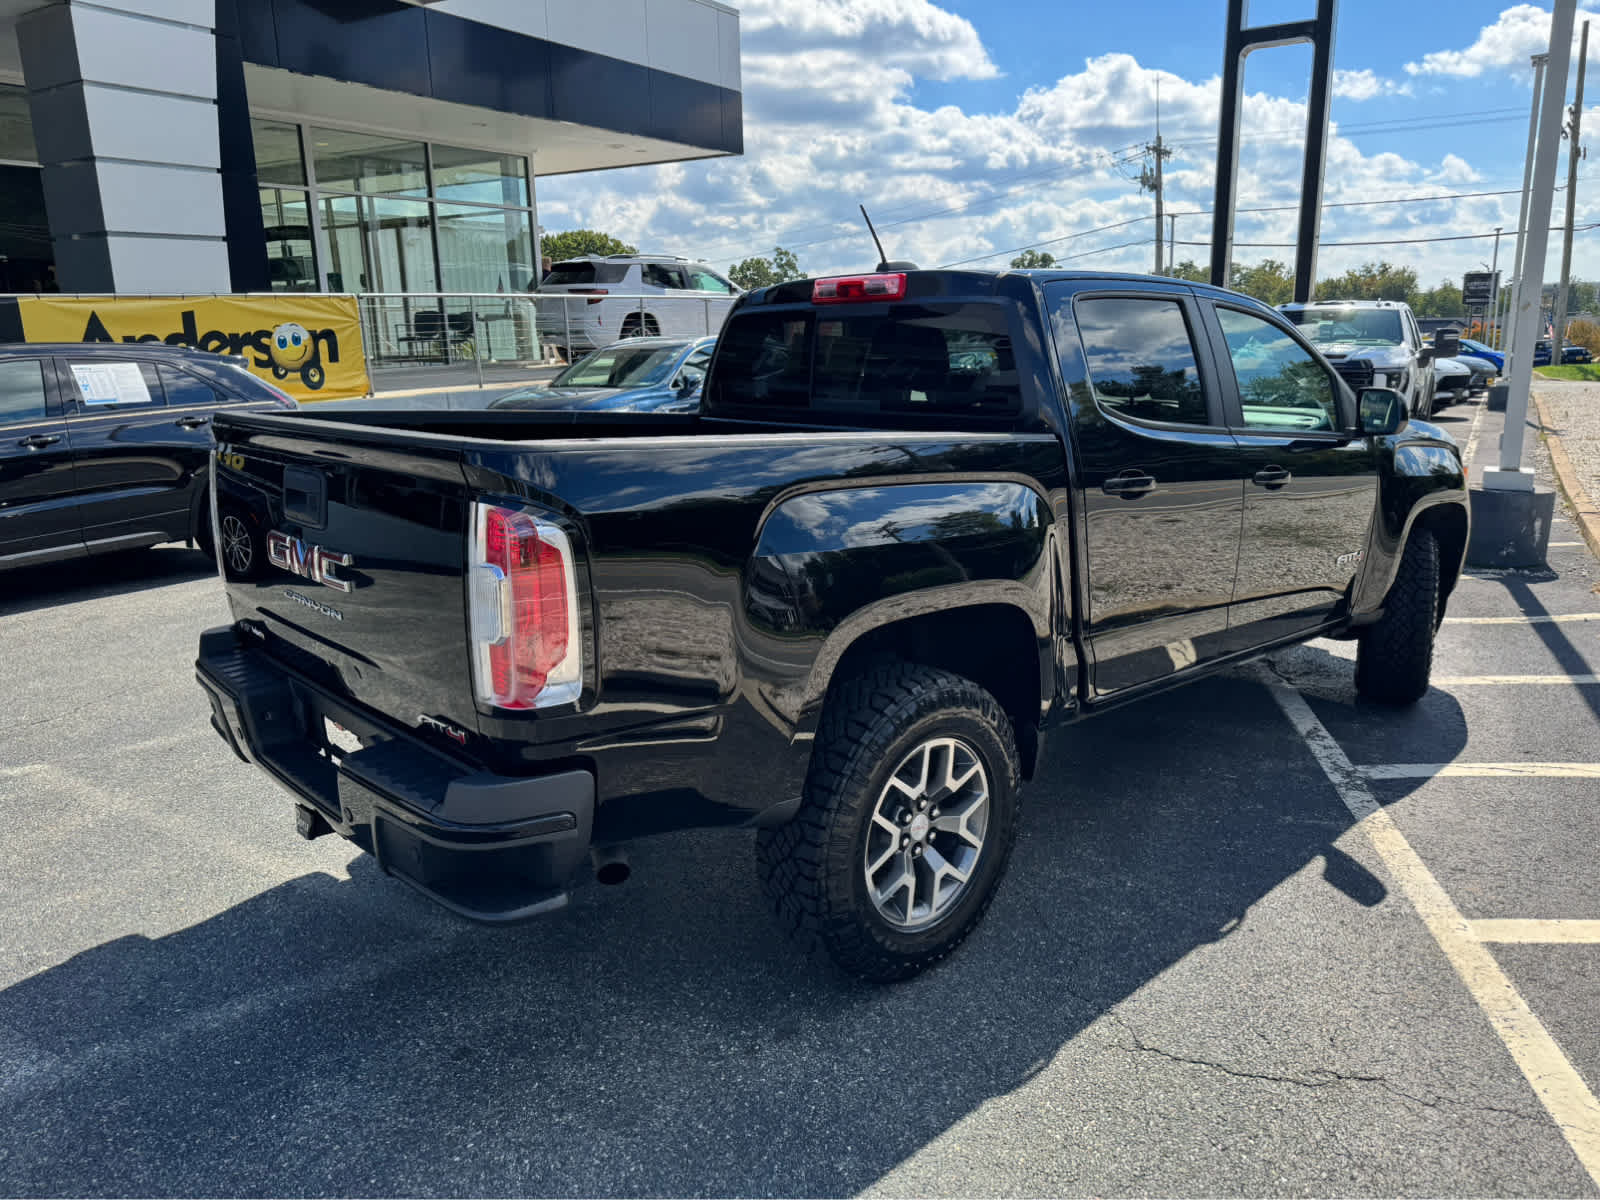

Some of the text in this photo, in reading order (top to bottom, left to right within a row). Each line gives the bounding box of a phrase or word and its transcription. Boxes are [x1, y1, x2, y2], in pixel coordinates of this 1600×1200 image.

[83, 310, 339, 369] Aderson
[267, 529, 351, 592] GMC
[284, 588, 343, 620] CANYON
[417, 714, 465, 745] AT4
